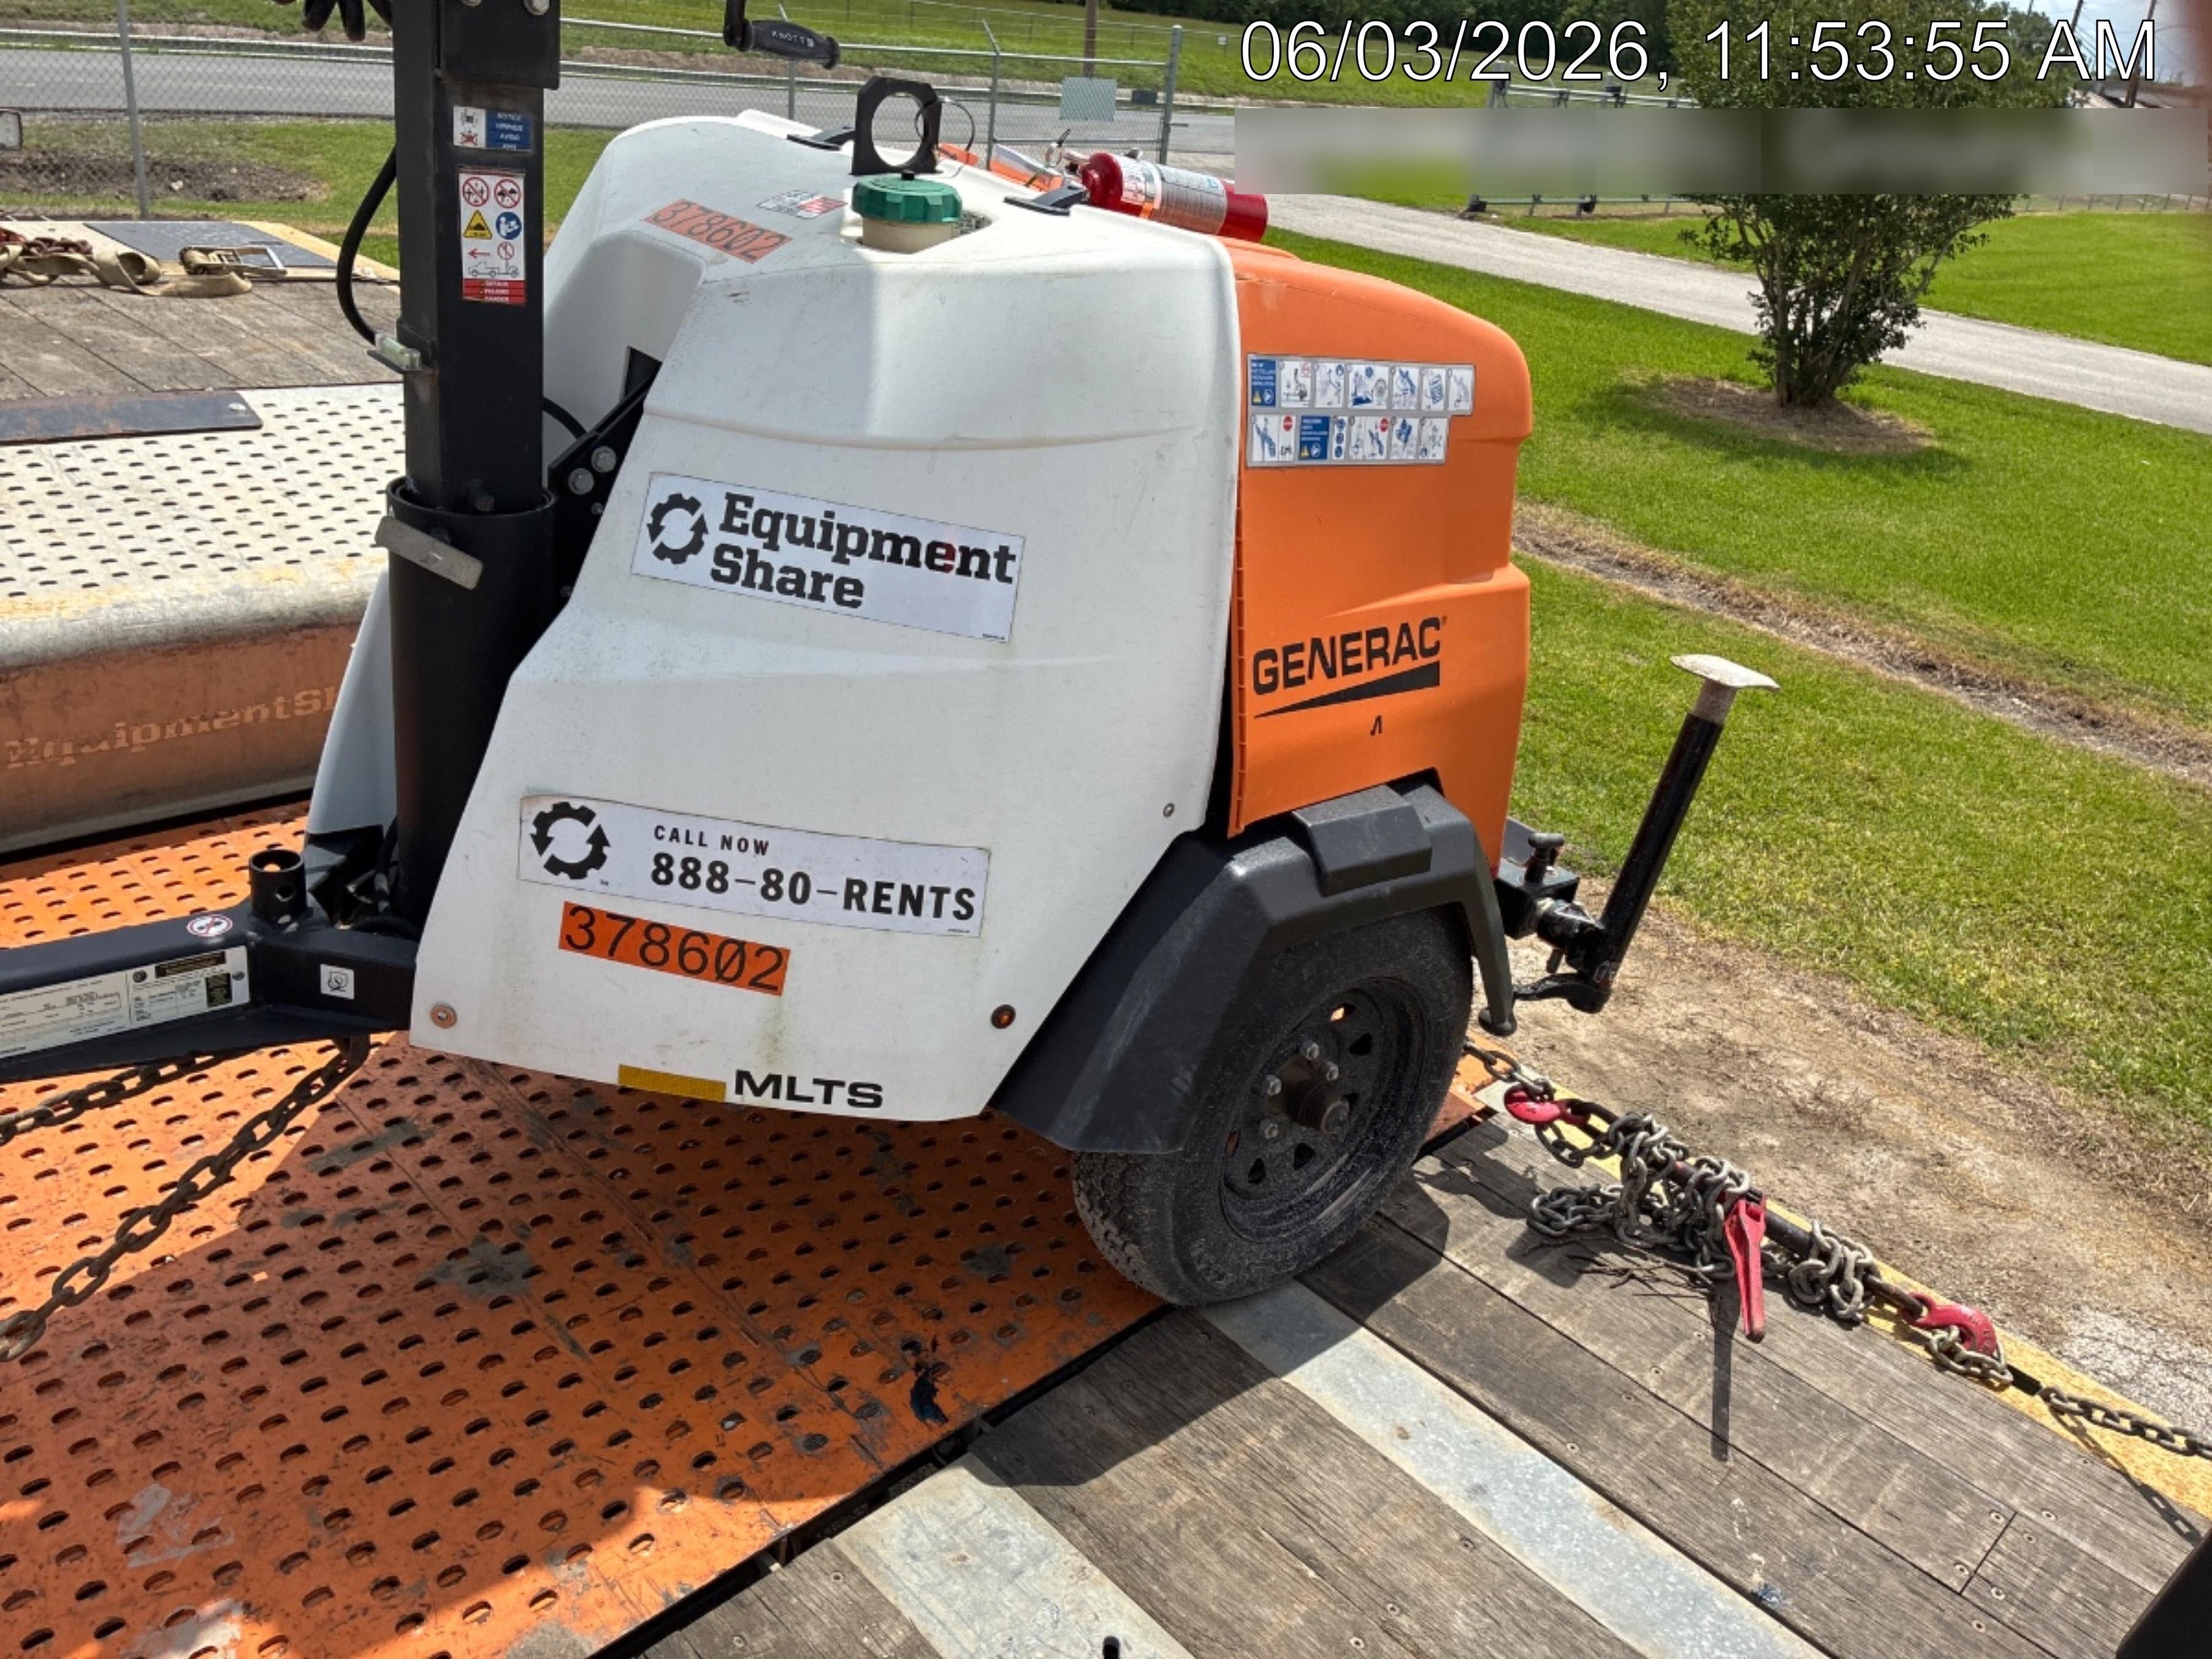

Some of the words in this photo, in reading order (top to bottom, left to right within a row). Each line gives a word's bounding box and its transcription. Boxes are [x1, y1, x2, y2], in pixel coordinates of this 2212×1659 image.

[652, 200, 786, 261] 378602
[719, 492, 1016, 584] Equipment
[710, 543, 865, 610] Share
[1253, 616, 1441, 696] GENERAC
[654, 825, 708, 847] CALL
[720, 834, 769, 856] NOW
[651, 852, 976, 920] 888-80-RENTS
[564, 905, 785, 993] 378602
[735, 1069, 883, 1108] MLTS
